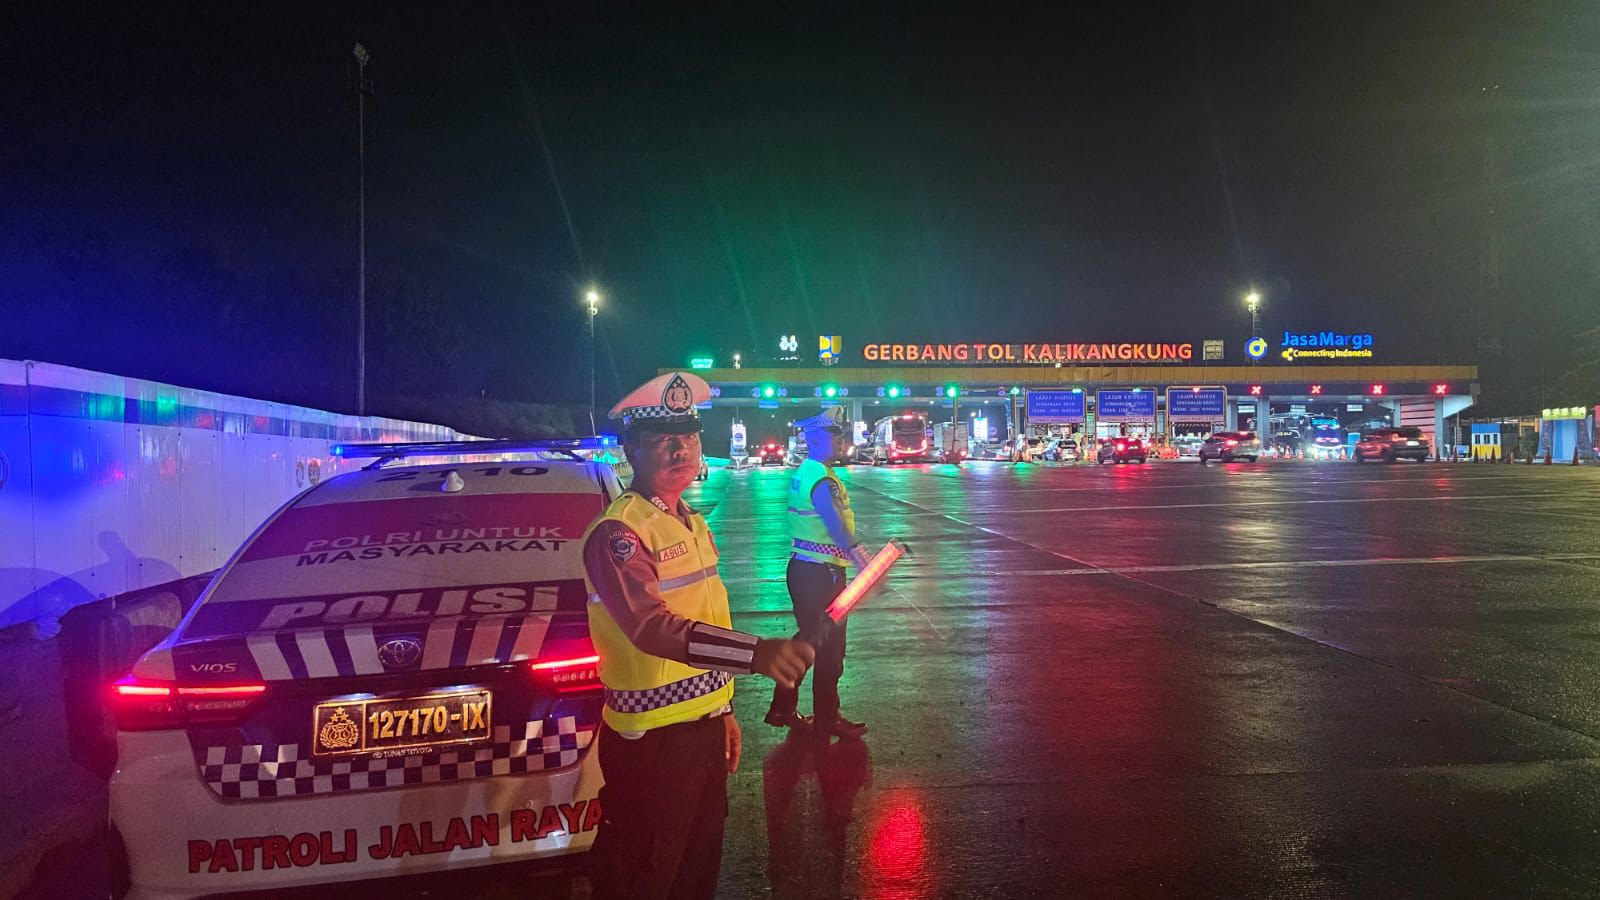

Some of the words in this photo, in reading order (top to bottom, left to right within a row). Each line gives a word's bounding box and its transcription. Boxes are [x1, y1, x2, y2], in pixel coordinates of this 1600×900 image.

[863, 344, 968, 360] GERBANG
[973, 344, 1015, 360] TOL
[1023, 343, 1192, 360] KALIKANGKUNG
[1293, 350, 1335, 358] Connecting
[1336, 349, 1372, 357] Indonesia
[303, 530, 421, 553] POLRI
[435, 526, 562, 541] UNTUK
[296, 540, 568, 566] MASYARAKAT
[260, 586, 560, 630] POLISI
[190, 662, 238, 673] VIOS
[369, 701, 487, 740] 127170-IX
[407, 746, 433, 755] TOYOTA
[188, 829, 358, 874] PATROLI
[368, 814, 499, 860] JALAN
[510, 799, 600, 843] RAYA
